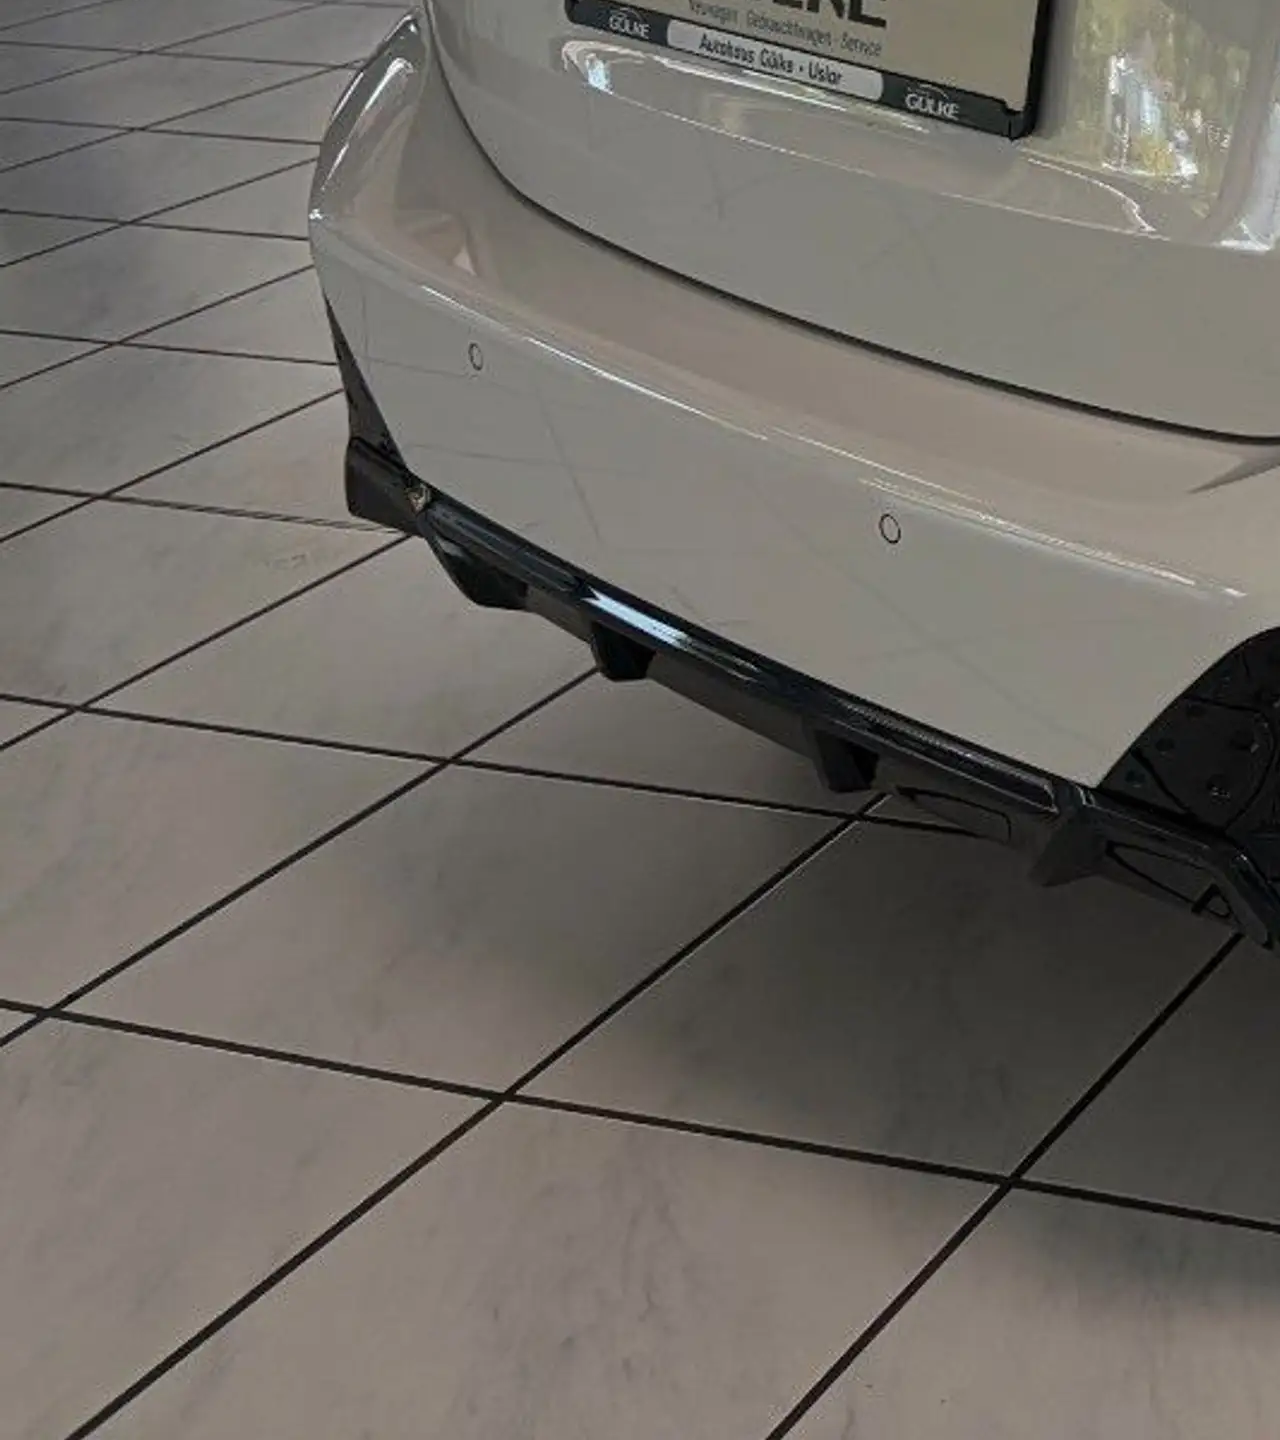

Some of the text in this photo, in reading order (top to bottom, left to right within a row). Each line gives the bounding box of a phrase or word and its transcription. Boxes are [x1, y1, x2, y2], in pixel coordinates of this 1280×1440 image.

[699, 33, 754, 64] Autohaus
[808, 60, 843, 86] Uslar
[839, 30, 882, 58] Service
